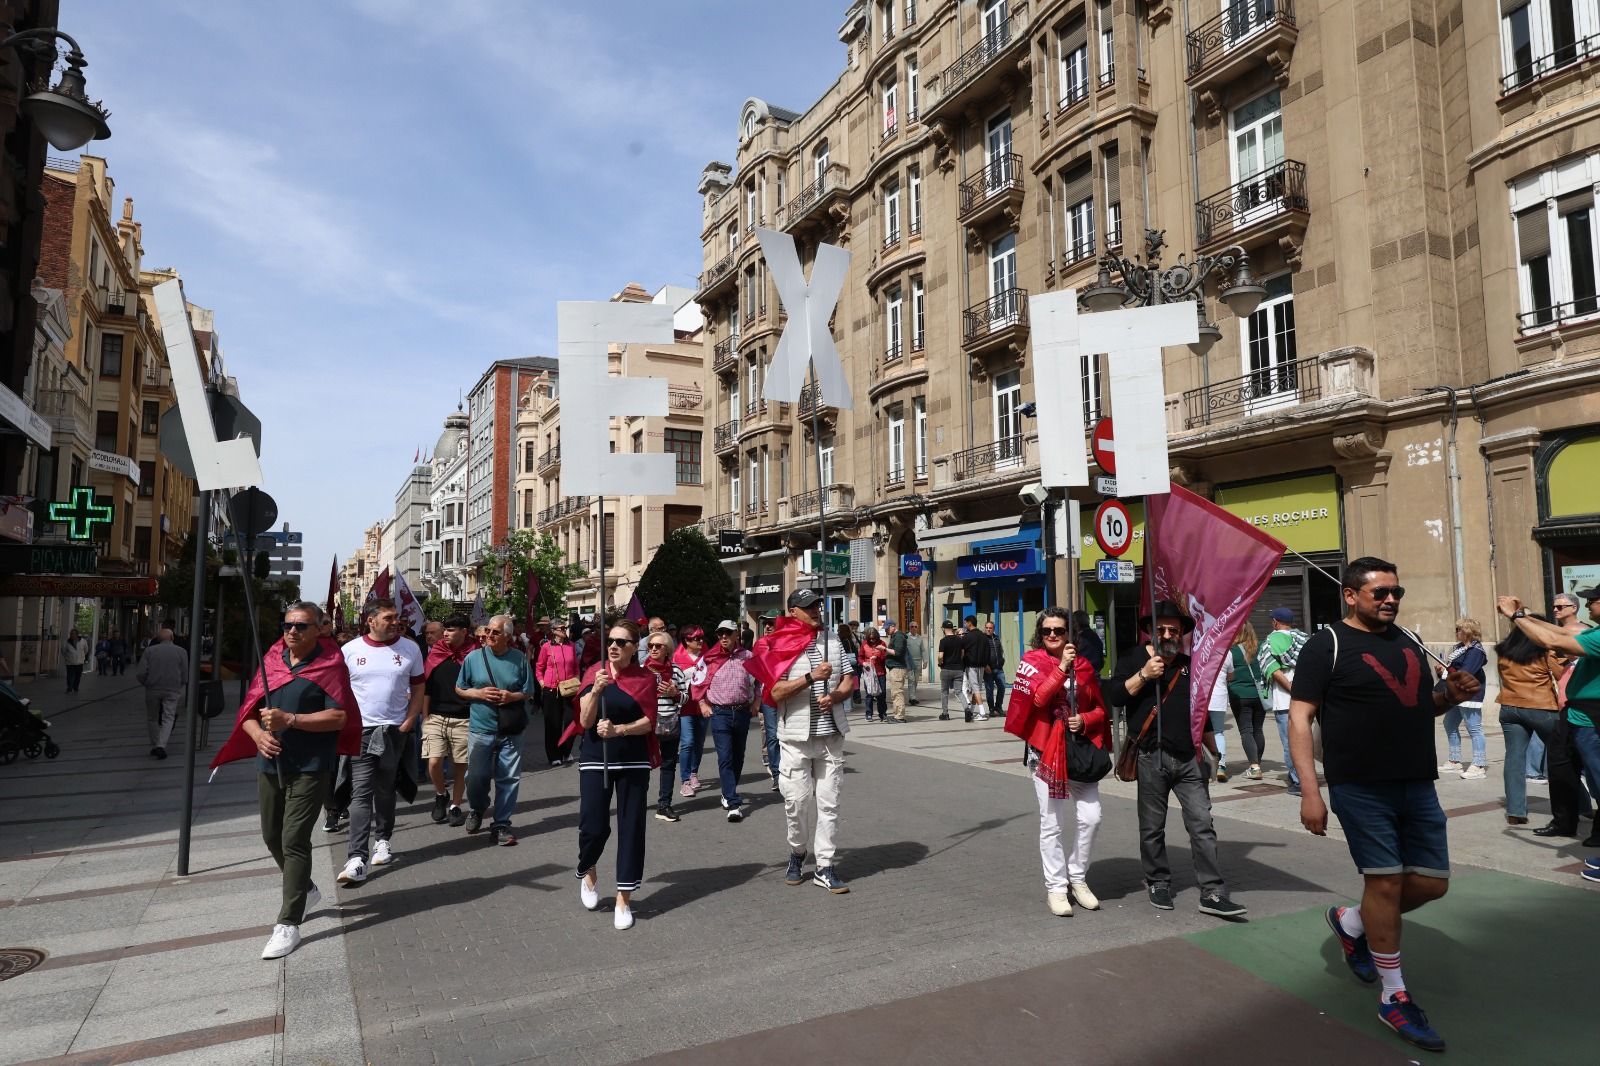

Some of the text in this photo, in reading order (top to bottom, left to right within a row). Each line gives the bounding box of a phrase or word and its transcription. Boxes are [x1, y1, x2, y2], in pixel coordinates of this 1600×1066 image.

[1242, 508, 1328, 524] VES ROCHER
[1107, 518, 1122, 537] 10
[973, 559, 999, 572] visión
[356, 657, 366, 666] 18
